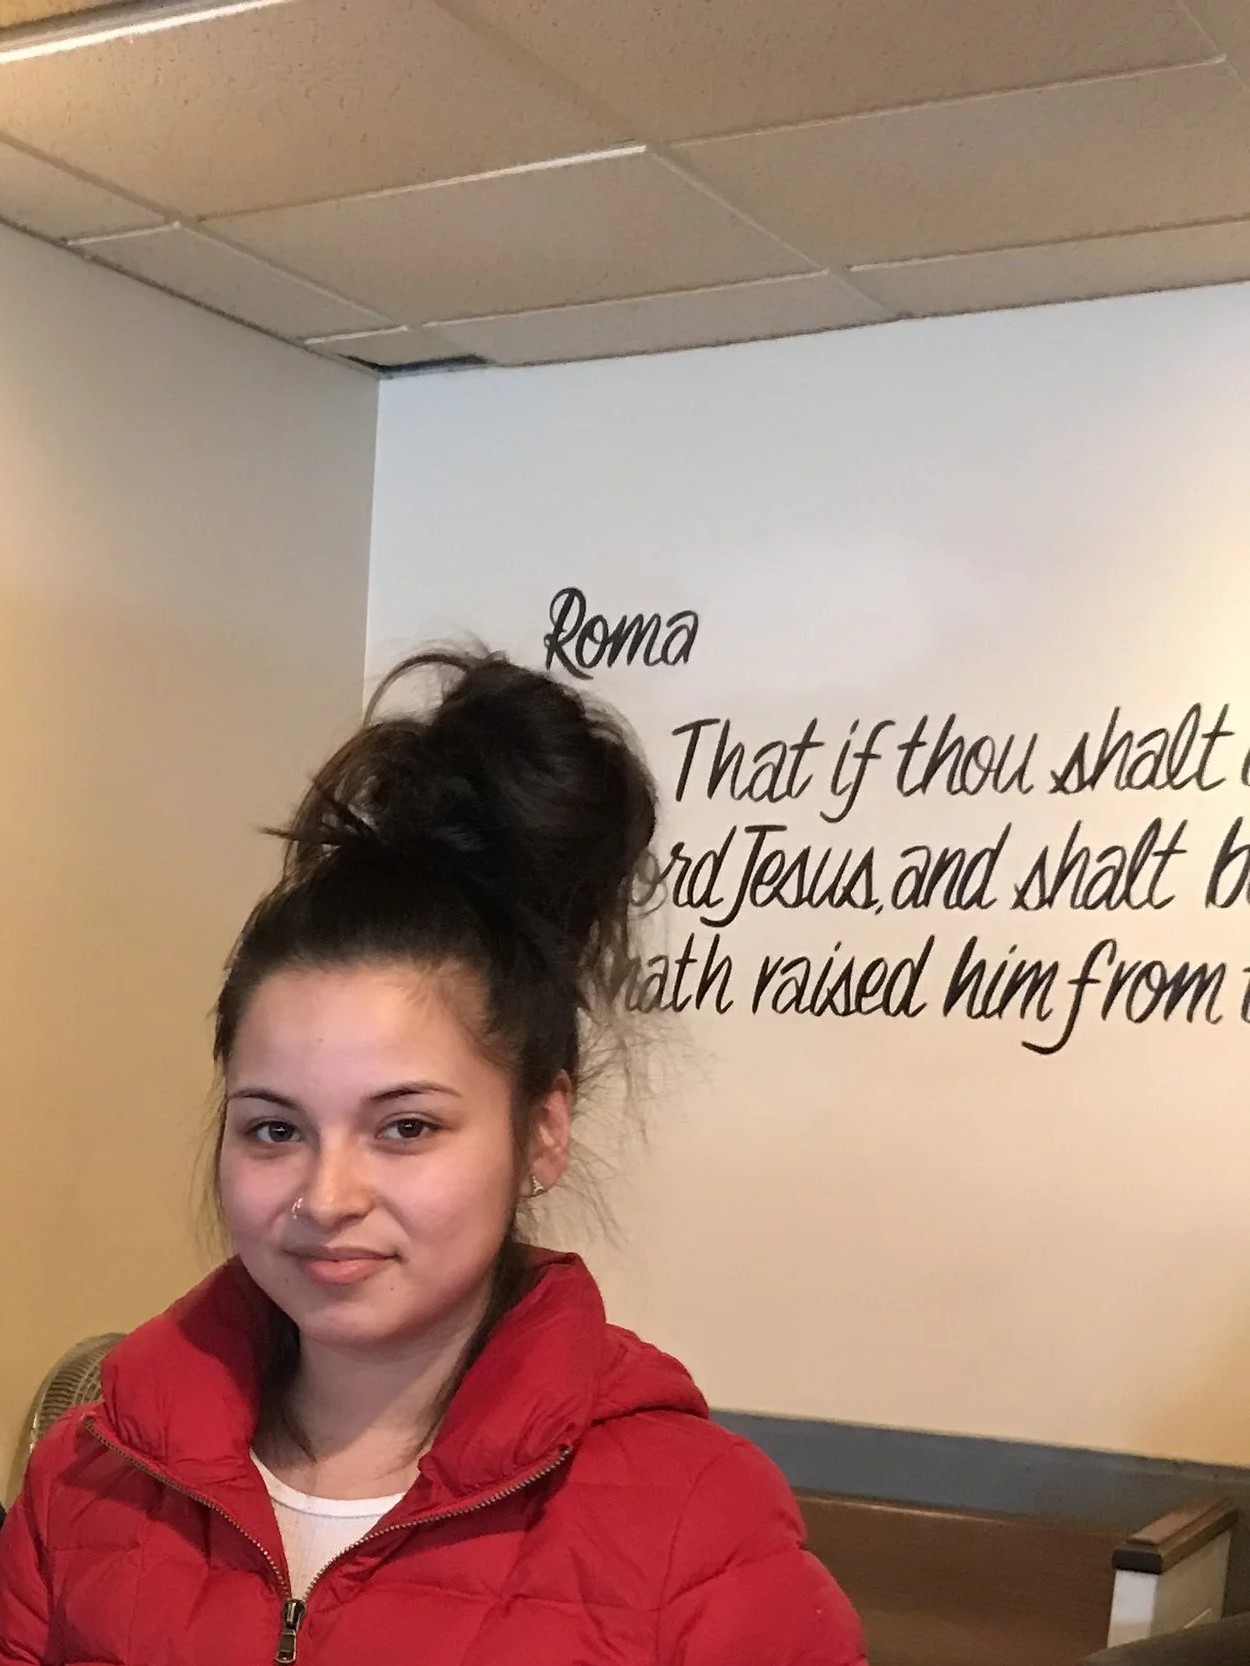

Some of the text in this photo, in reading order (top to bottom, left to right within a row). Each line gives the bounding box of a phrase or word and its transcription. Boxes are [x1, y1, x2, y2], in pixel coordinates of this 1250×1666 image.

[544, 586, 699, 679] Roma
[671, 715, 824, 803] That
[819, 719, 896, 823] if
[897, 713, 1038, 797] thou
[1049, 702, 1233, 795] shalt
[700, 823, 885, 928] Jesus,
[891, 822, 1012, 911] and
[1012, 817, 1189, 912] shalt
[750, 934, 937, 1018] raised
[943, 935, 1058, 1022] him
[1020, 938, 1225, 1055] from
